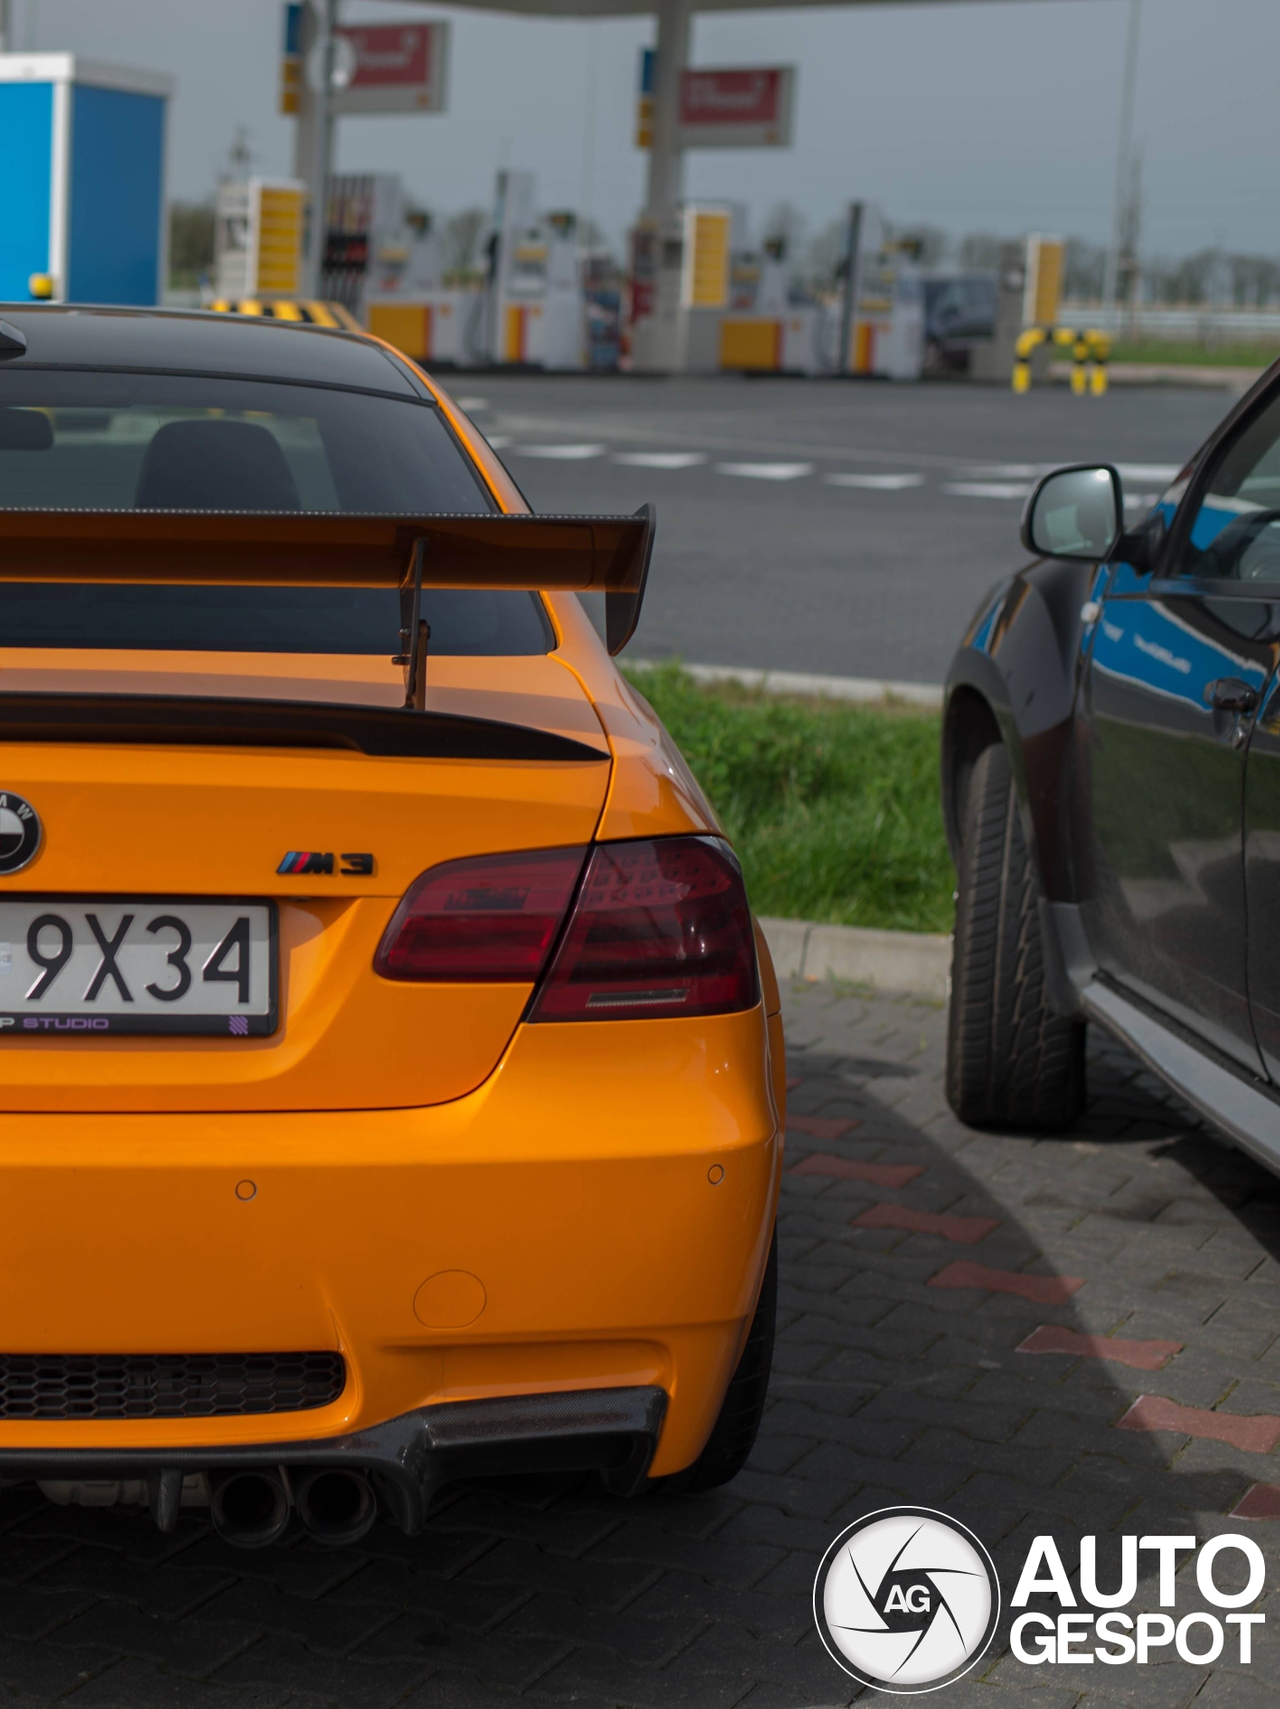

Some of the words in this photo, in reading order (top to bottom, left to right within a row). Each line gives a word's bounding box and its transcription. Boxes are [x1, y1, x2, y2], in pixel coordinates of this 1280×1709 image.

[275, 851, 373, 875] M3
[24, 913, 251, 1003] 9X34
[22, 1017, 110, 1030] STUDIO
